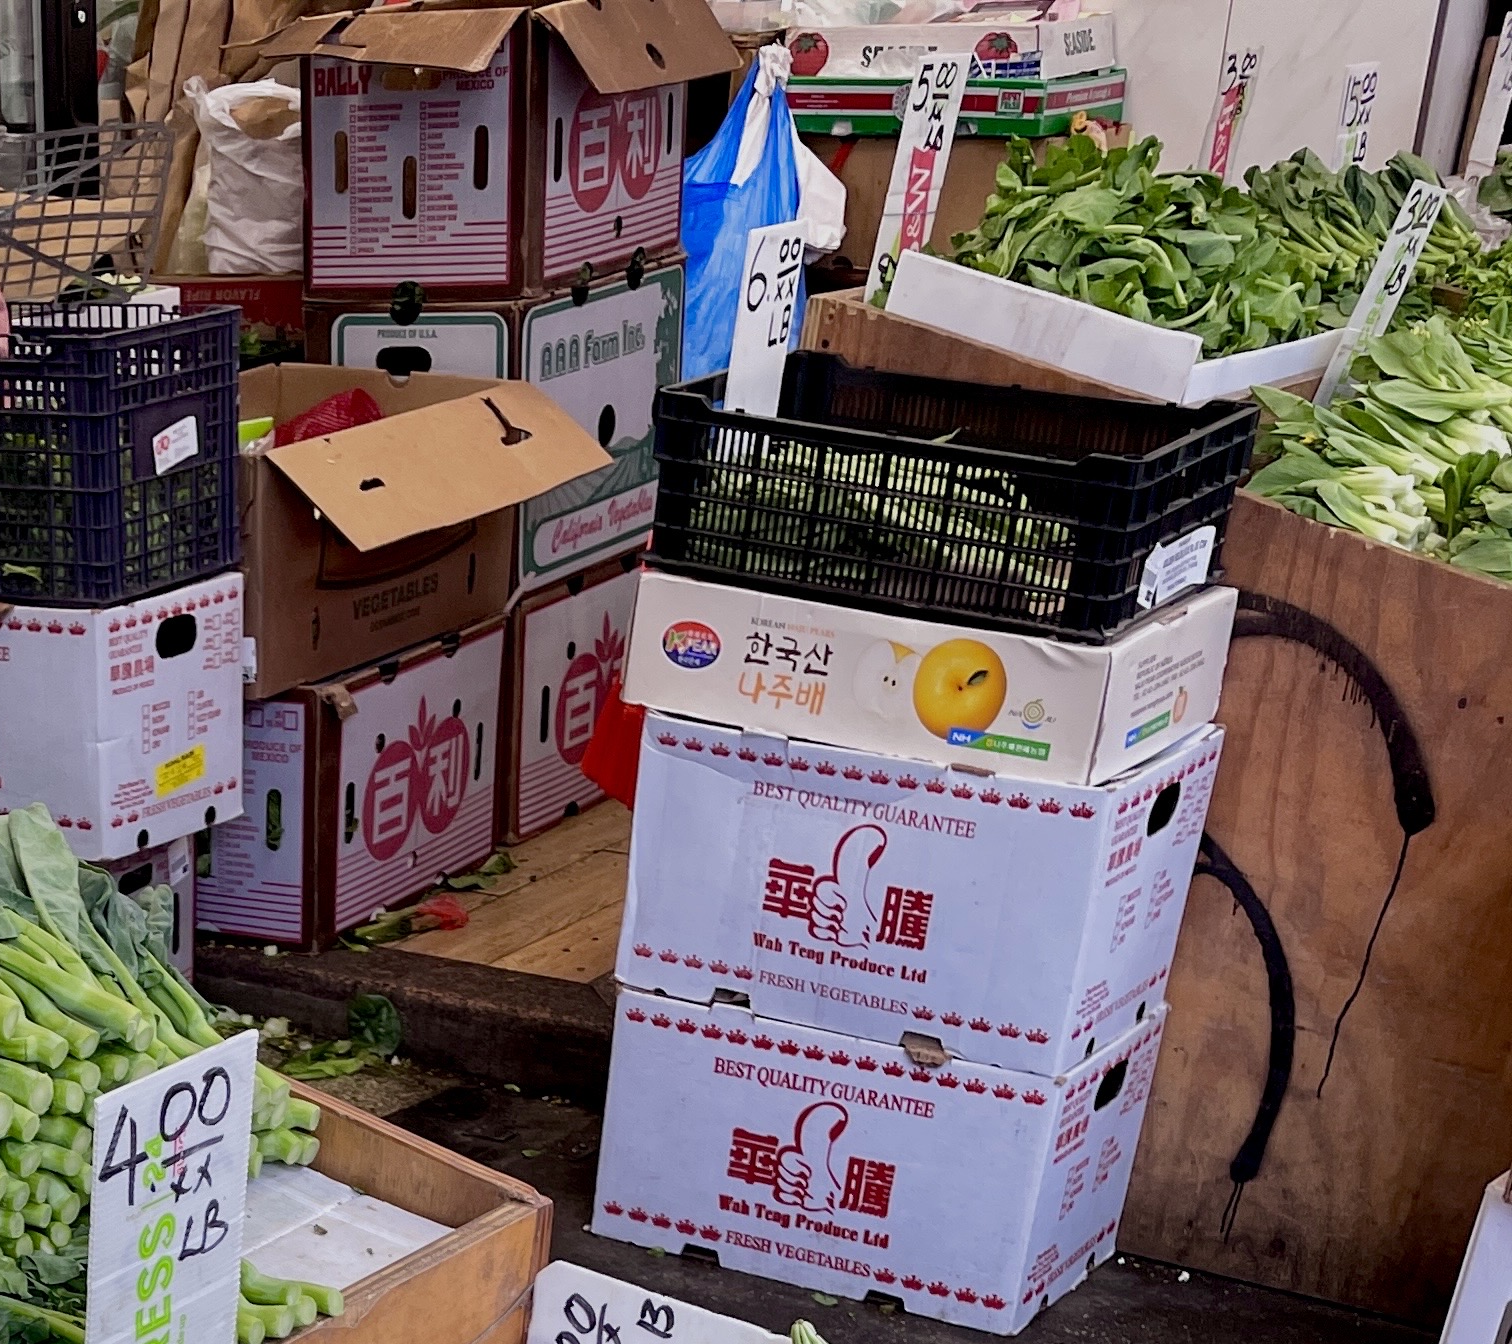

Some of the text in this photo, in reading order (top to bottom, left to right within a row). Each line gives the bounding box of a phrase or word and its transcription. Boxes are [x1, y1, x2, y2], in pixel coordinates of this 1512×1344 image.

[314, 65, 373, 97] BALLY
[455, 79, 495, 91] MEXICO
[495, 66, 509, 77] OF
[577, 96, 656, 191] 百利
[1352, 131, 1368, 162] LB
[747, 235, 801, 312] 6.00
[377, 329, 407, 339] PRODUCE
[408, 330, 417, 339] OF
[768, 303, 792, 347] LB
[583, 329, 620, 368] Farm
[352, 572, 439, 620] VEGETABLES
[750, 616, 786, 630] KOREAN
[744, 631, 834, 677] 한국산
[738, 671, 827, 716] 나주배
[244, 740, 286, 753] RODUCE
[952, 731, 972, 743] NH
[372, 734, 463, 845] 百利
[753, 780, 976, 839] BEST QUALITY GUARANTEE
[752, 930, 928, 985] Wah Teng Produce Ltd
[759, 968, 909, 1016] FRESH VEGETABLES
[714, 1056, 936, 1119] BEST QUALITY GUARANTEE
[98, 1066, 232, 1207] 4.00
[177, 1199, 230, 1262] LB
[718, 1193, 890, 1250] Wah Teng Produce Ltd
[724, 1229, 872, 1278] FRESH VEGETABLES
[178, 1313, 188, 1330] up
